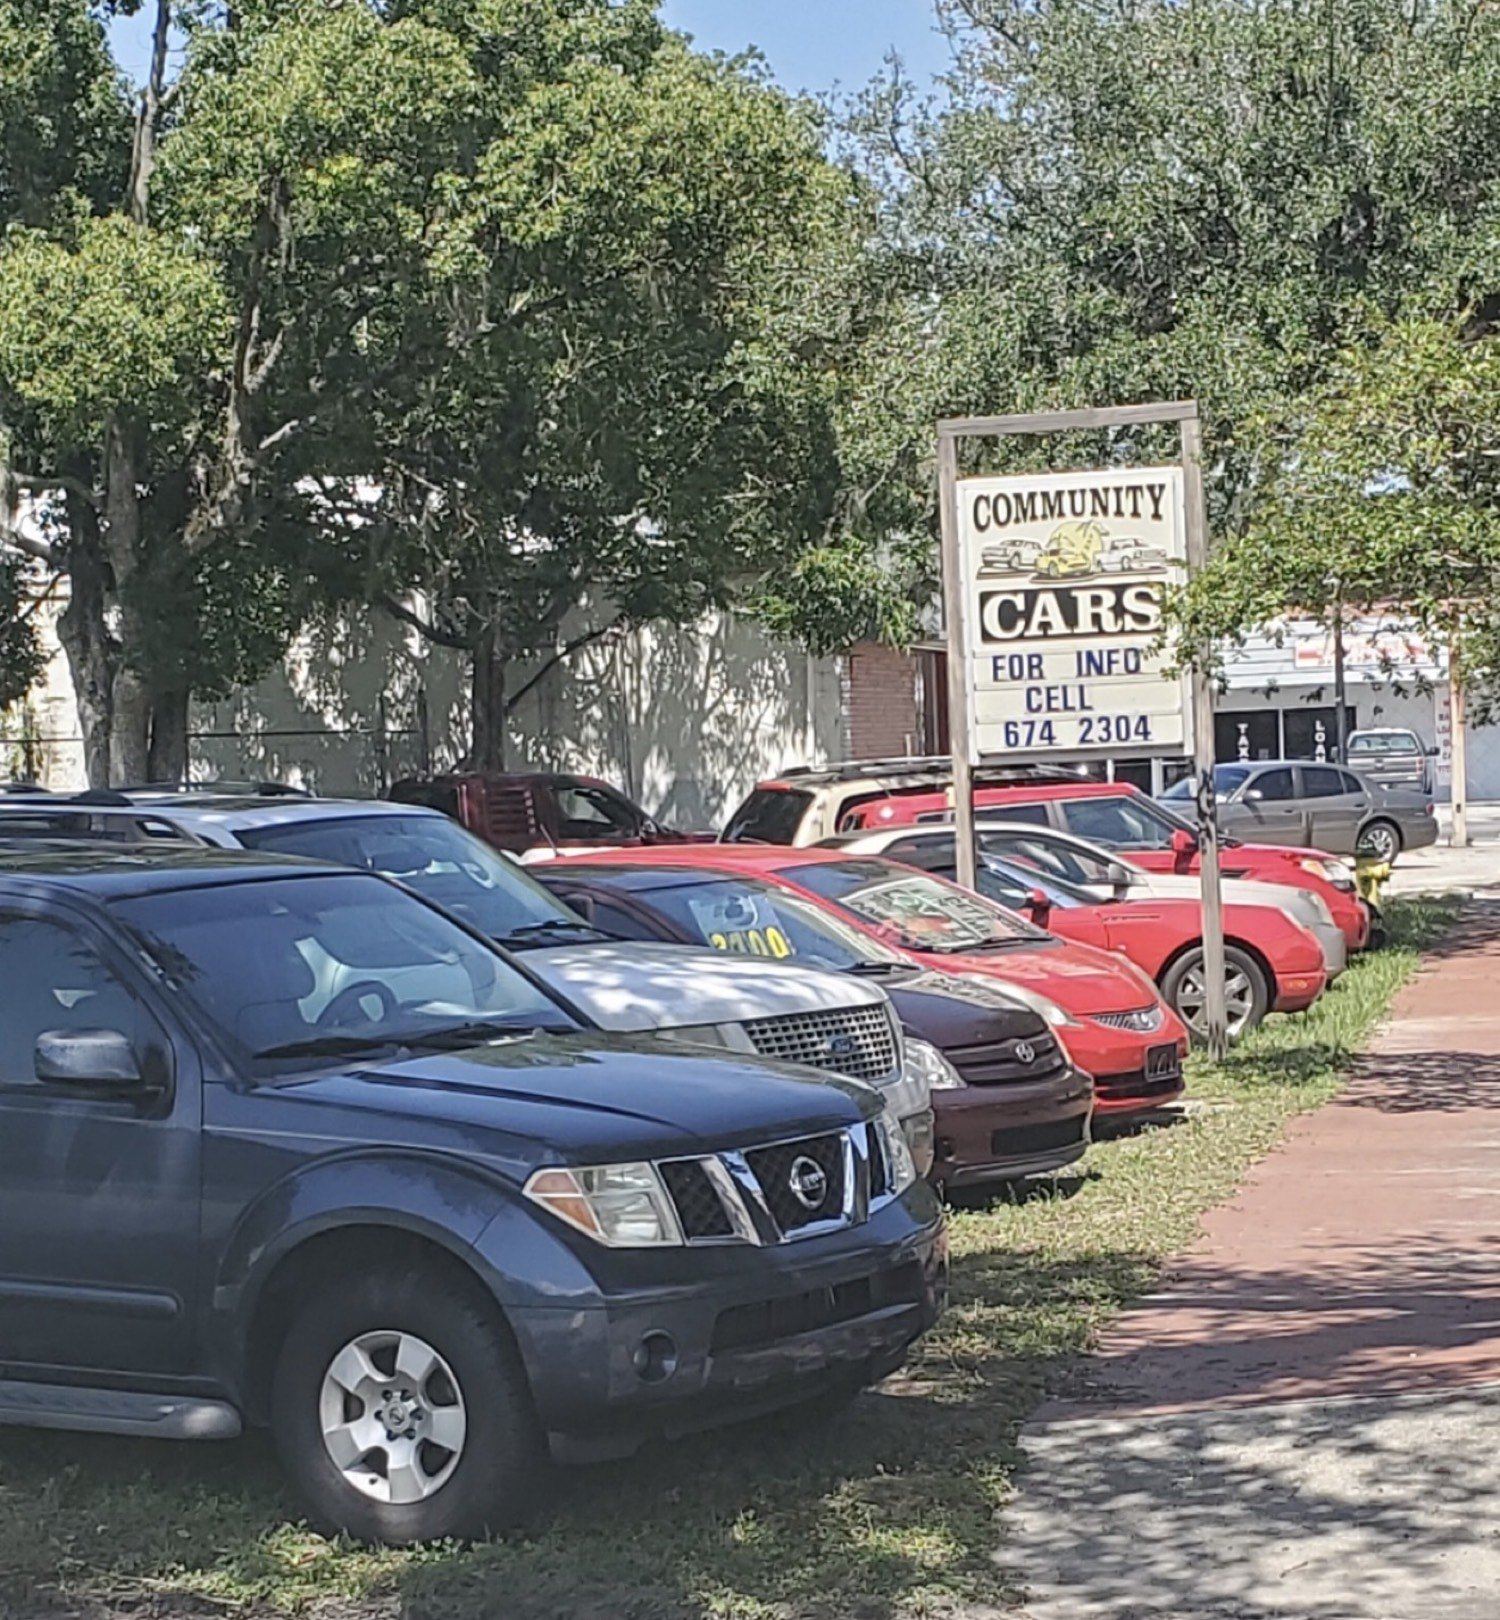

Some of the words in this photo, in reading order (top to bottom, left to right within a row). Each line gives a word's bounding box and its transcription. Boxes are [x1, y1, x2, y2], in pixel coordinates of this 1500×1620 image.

[973, 483, 1166, 533] COMMUNITY
[982, 584, 1164, 639] CARS
[992, 653, 1044, 682] FOR
[1076, 647, 1141, 678] INFO
[1026, 684, 1093, 713] CELL
[1004, 720, 1057, 747] 674
[1078, 715, 1152, 743] 2304
